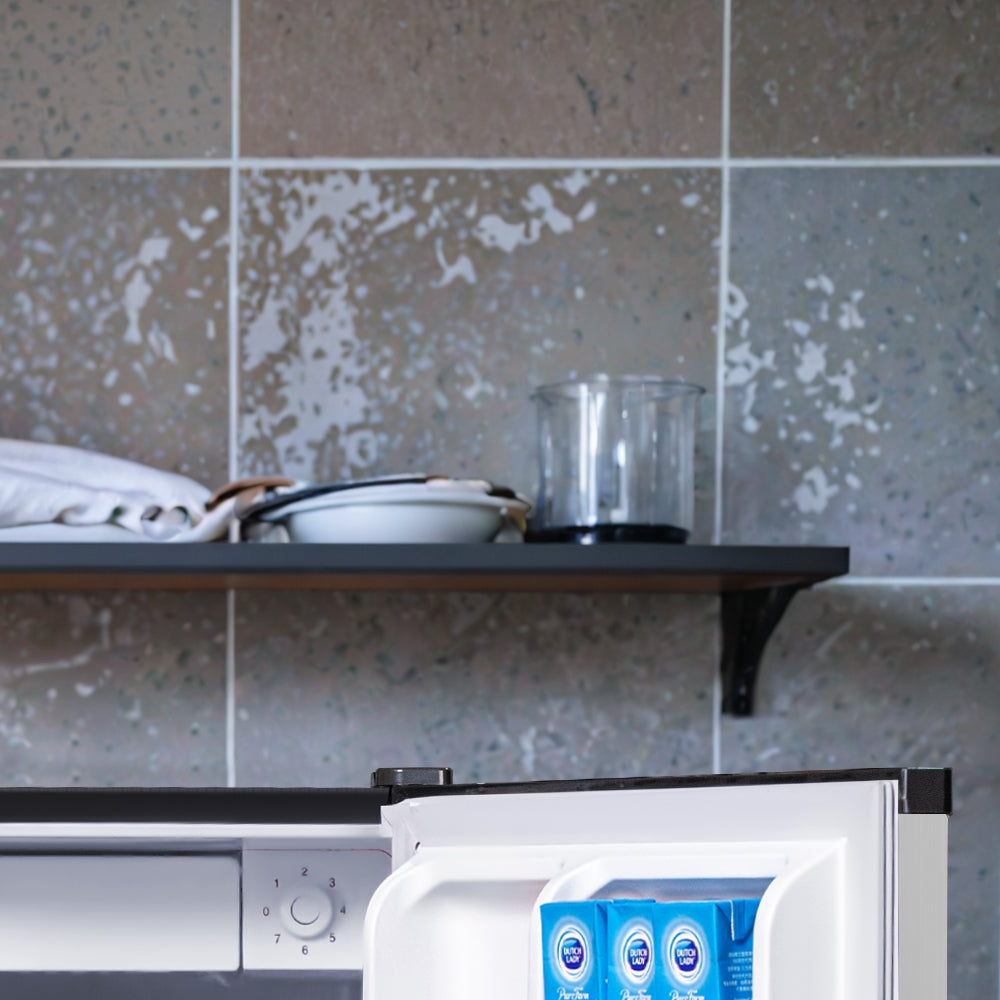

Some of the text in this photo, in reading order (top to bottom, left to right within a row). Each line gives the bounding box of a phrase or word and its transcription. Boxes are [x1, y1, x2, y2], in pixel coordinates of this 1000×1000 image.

[301, 867, 308, 876] 2
[274, 878, 279, 888] 1
[329, 877, 336, 888] 3
[262, 906, 270, 917] 0
[340, 905, 346, 915] 4
[274, 933, 281, 944] 7
[329, 933, 336, 943] 5
[302, 945, 308, 956] 6
[563, 947, 582, 955] DUTCH
[630, 949, 647, 957] DUTCH
[676, 949, 696, 957] DUTCH
[632, 957, 646, 965] LADY
[679, 957, 694, 965] LADY
